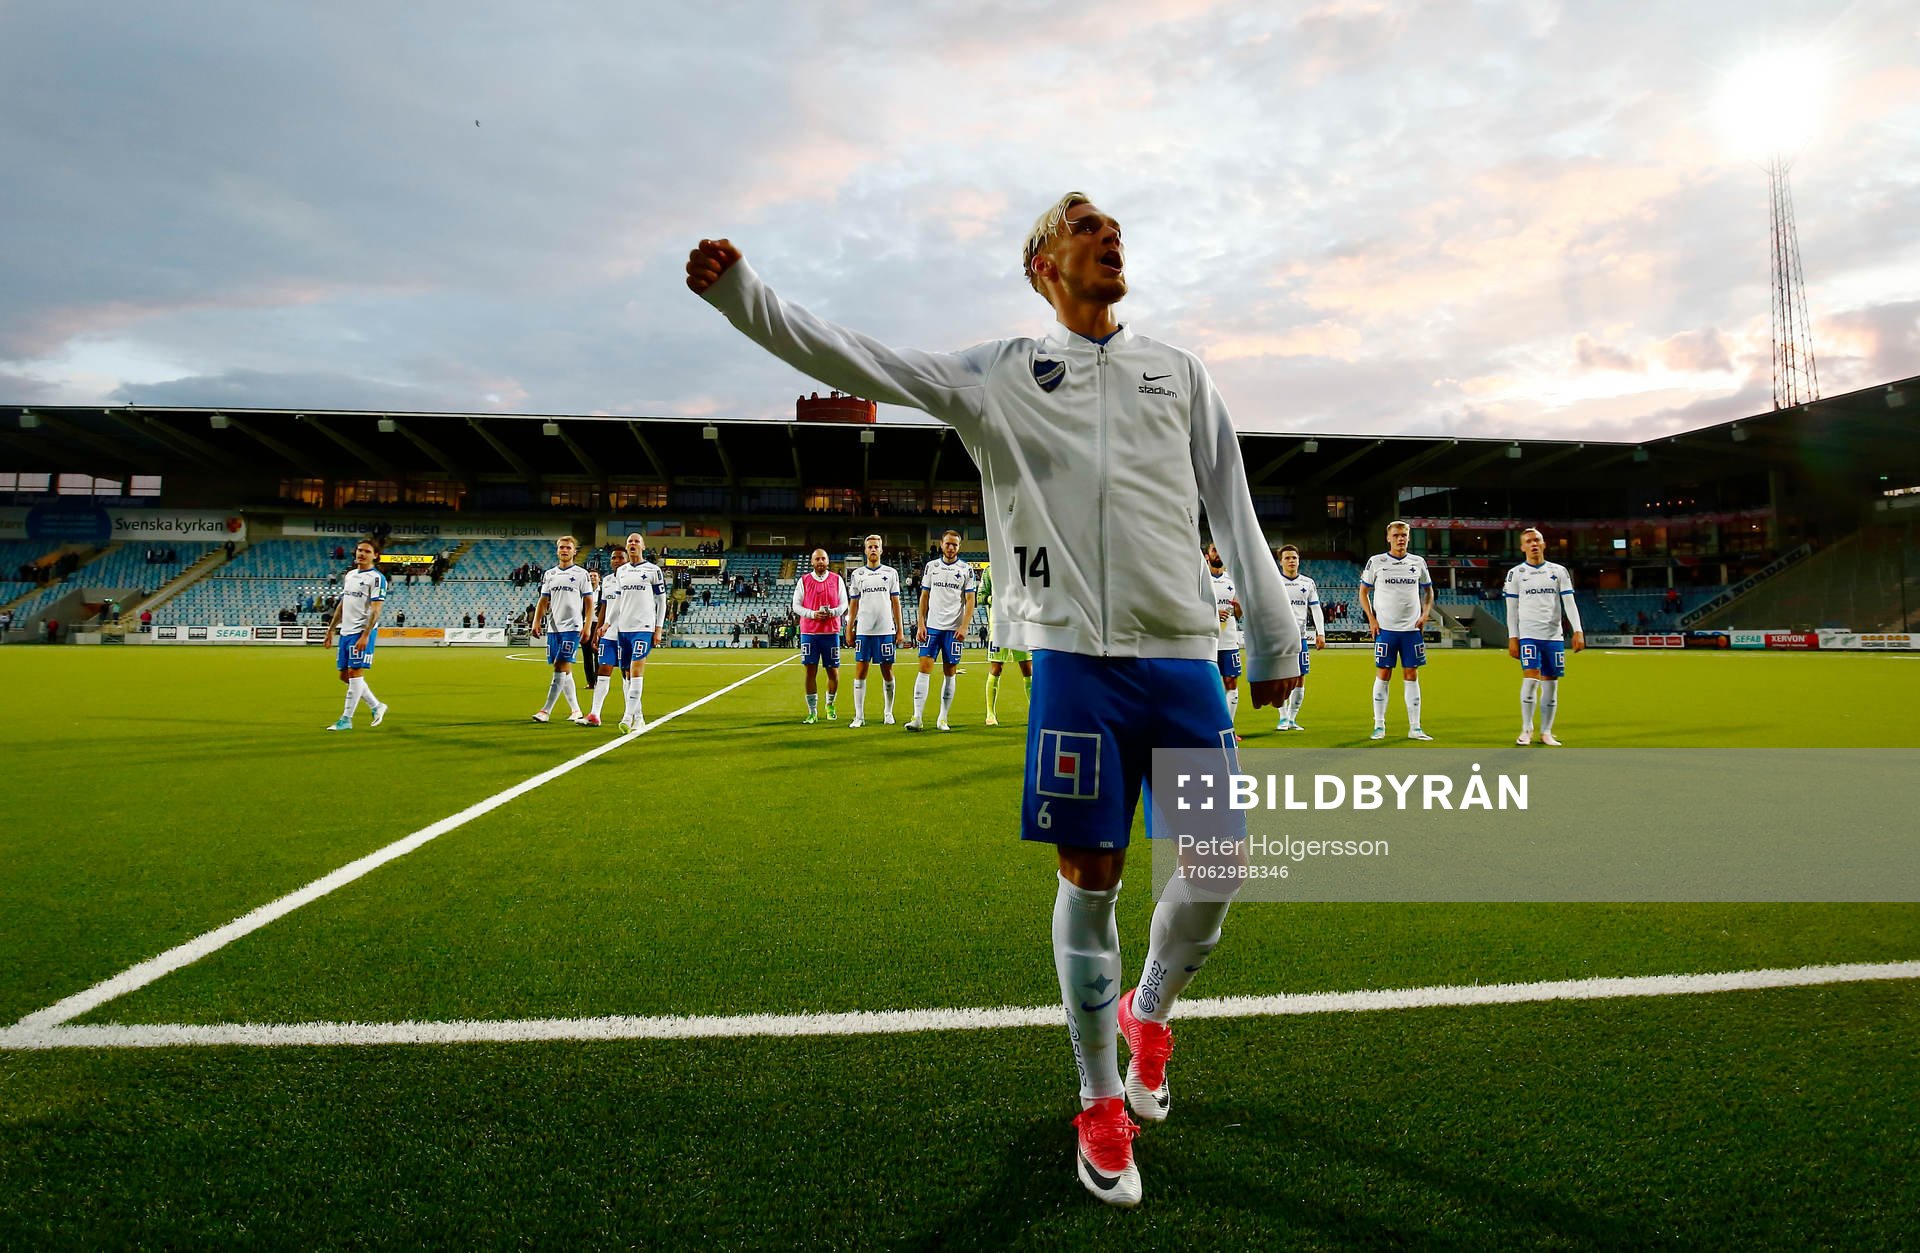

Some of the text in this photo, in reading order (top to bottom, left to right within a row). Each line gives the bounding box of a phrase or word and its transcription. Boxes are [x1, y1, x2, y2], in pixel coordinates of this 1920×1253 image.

[1138, 384, 1178, 399] stadium
[115, 518, 173, 532] Svenska
[175, 518, 224, 534] kyrkan
[511, 525, 544, 537] bank
[862, 586, 888, 594] HOLMEN
[933, 581, 960, 590] HOLMEN
[1525, 587, 1557, 595] HOLMEN
[215, 629, 249, 638] SEFAB
[1734, 634, 1761, 643] SEFAB
[1770, 634, 1806, 643] XERVON
[1037, 801, 1052, 830] 6
